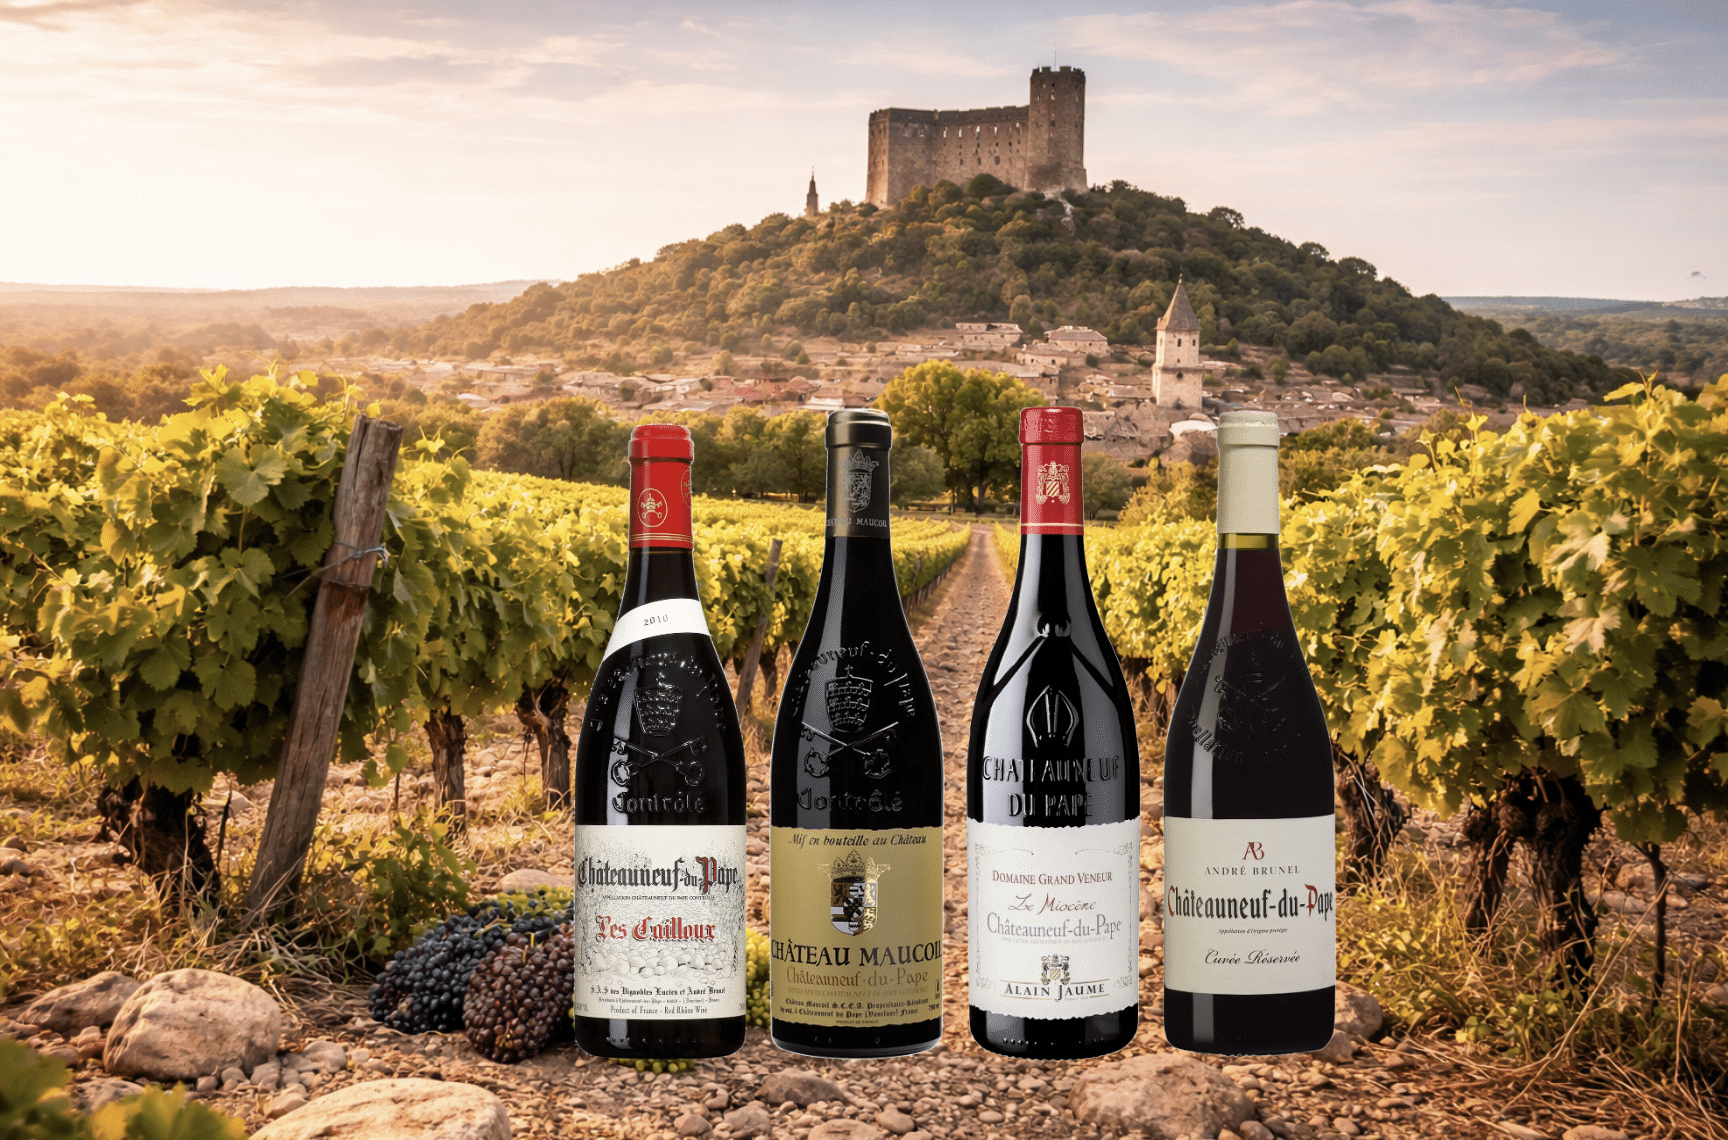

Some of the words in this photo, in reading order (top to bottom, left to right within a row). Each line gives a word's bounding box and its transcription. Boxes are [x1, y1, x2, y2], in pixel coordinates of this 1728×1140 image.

[856, 517, 887, 527] MAUCOIL
[643, 614, 669, 626] 2010
[1009, 793, 1033, 817] DU
[1046, 793, 1094, 817] PAPE
[809, 836, 819, 845] en
[823, 834, 869, 847] bouteille
[872, 837, 886, 845] au
[890, 833, 927, 845] Château
[1242, 841, 1265, 860] AB
[992, 870, 1036, 885] DOMAINE
[1038, 873, 1075, 885] GRAND
[1077, 871, 1113, 884] VENEUR
[1204, 865, 1247, 876] ANDRÉ
[1253, 865, 1300, 876] BRUNEL
[1007, 893, 1034, 912] Le
[1036, 892, 1097, 916] Miocène
[1167, 883, 1333, 922] Châteauneuf-du-Pape
[596, 915, 627, 941] Les
[631, 916, 717, 942] Cailloux
[986, 911, 1122, 939] Châteauneuf-du-Pape
[771, 938, 850, 966] CHÂTEAU
[859, 940, 942, 966] MAUCOIL
[1204, 948, 1241, 965] Cuvée
[1243, 949, 1301, 965] Réservée
[654, 986, 678, 996] Lucien
[1003, 982, 1050, 997] ALAIN
[1053, 983, 1105, 1003] JAUME
[611, 1005, 630, 1014] Product
[632, 1006, 638, 1014] of
[640, 1005, 658, 1014] France
[664, 1005, 675, 1014] Red
[677, 1005, 694, 1014] Rhône
[695, 1005, 708, 1014] Wine
[806, 1000, 830, 1009] Maucoil
[799, 1008, 833, 1017] Châteauneuf
[846, 1010, 862, 1018] Pape
